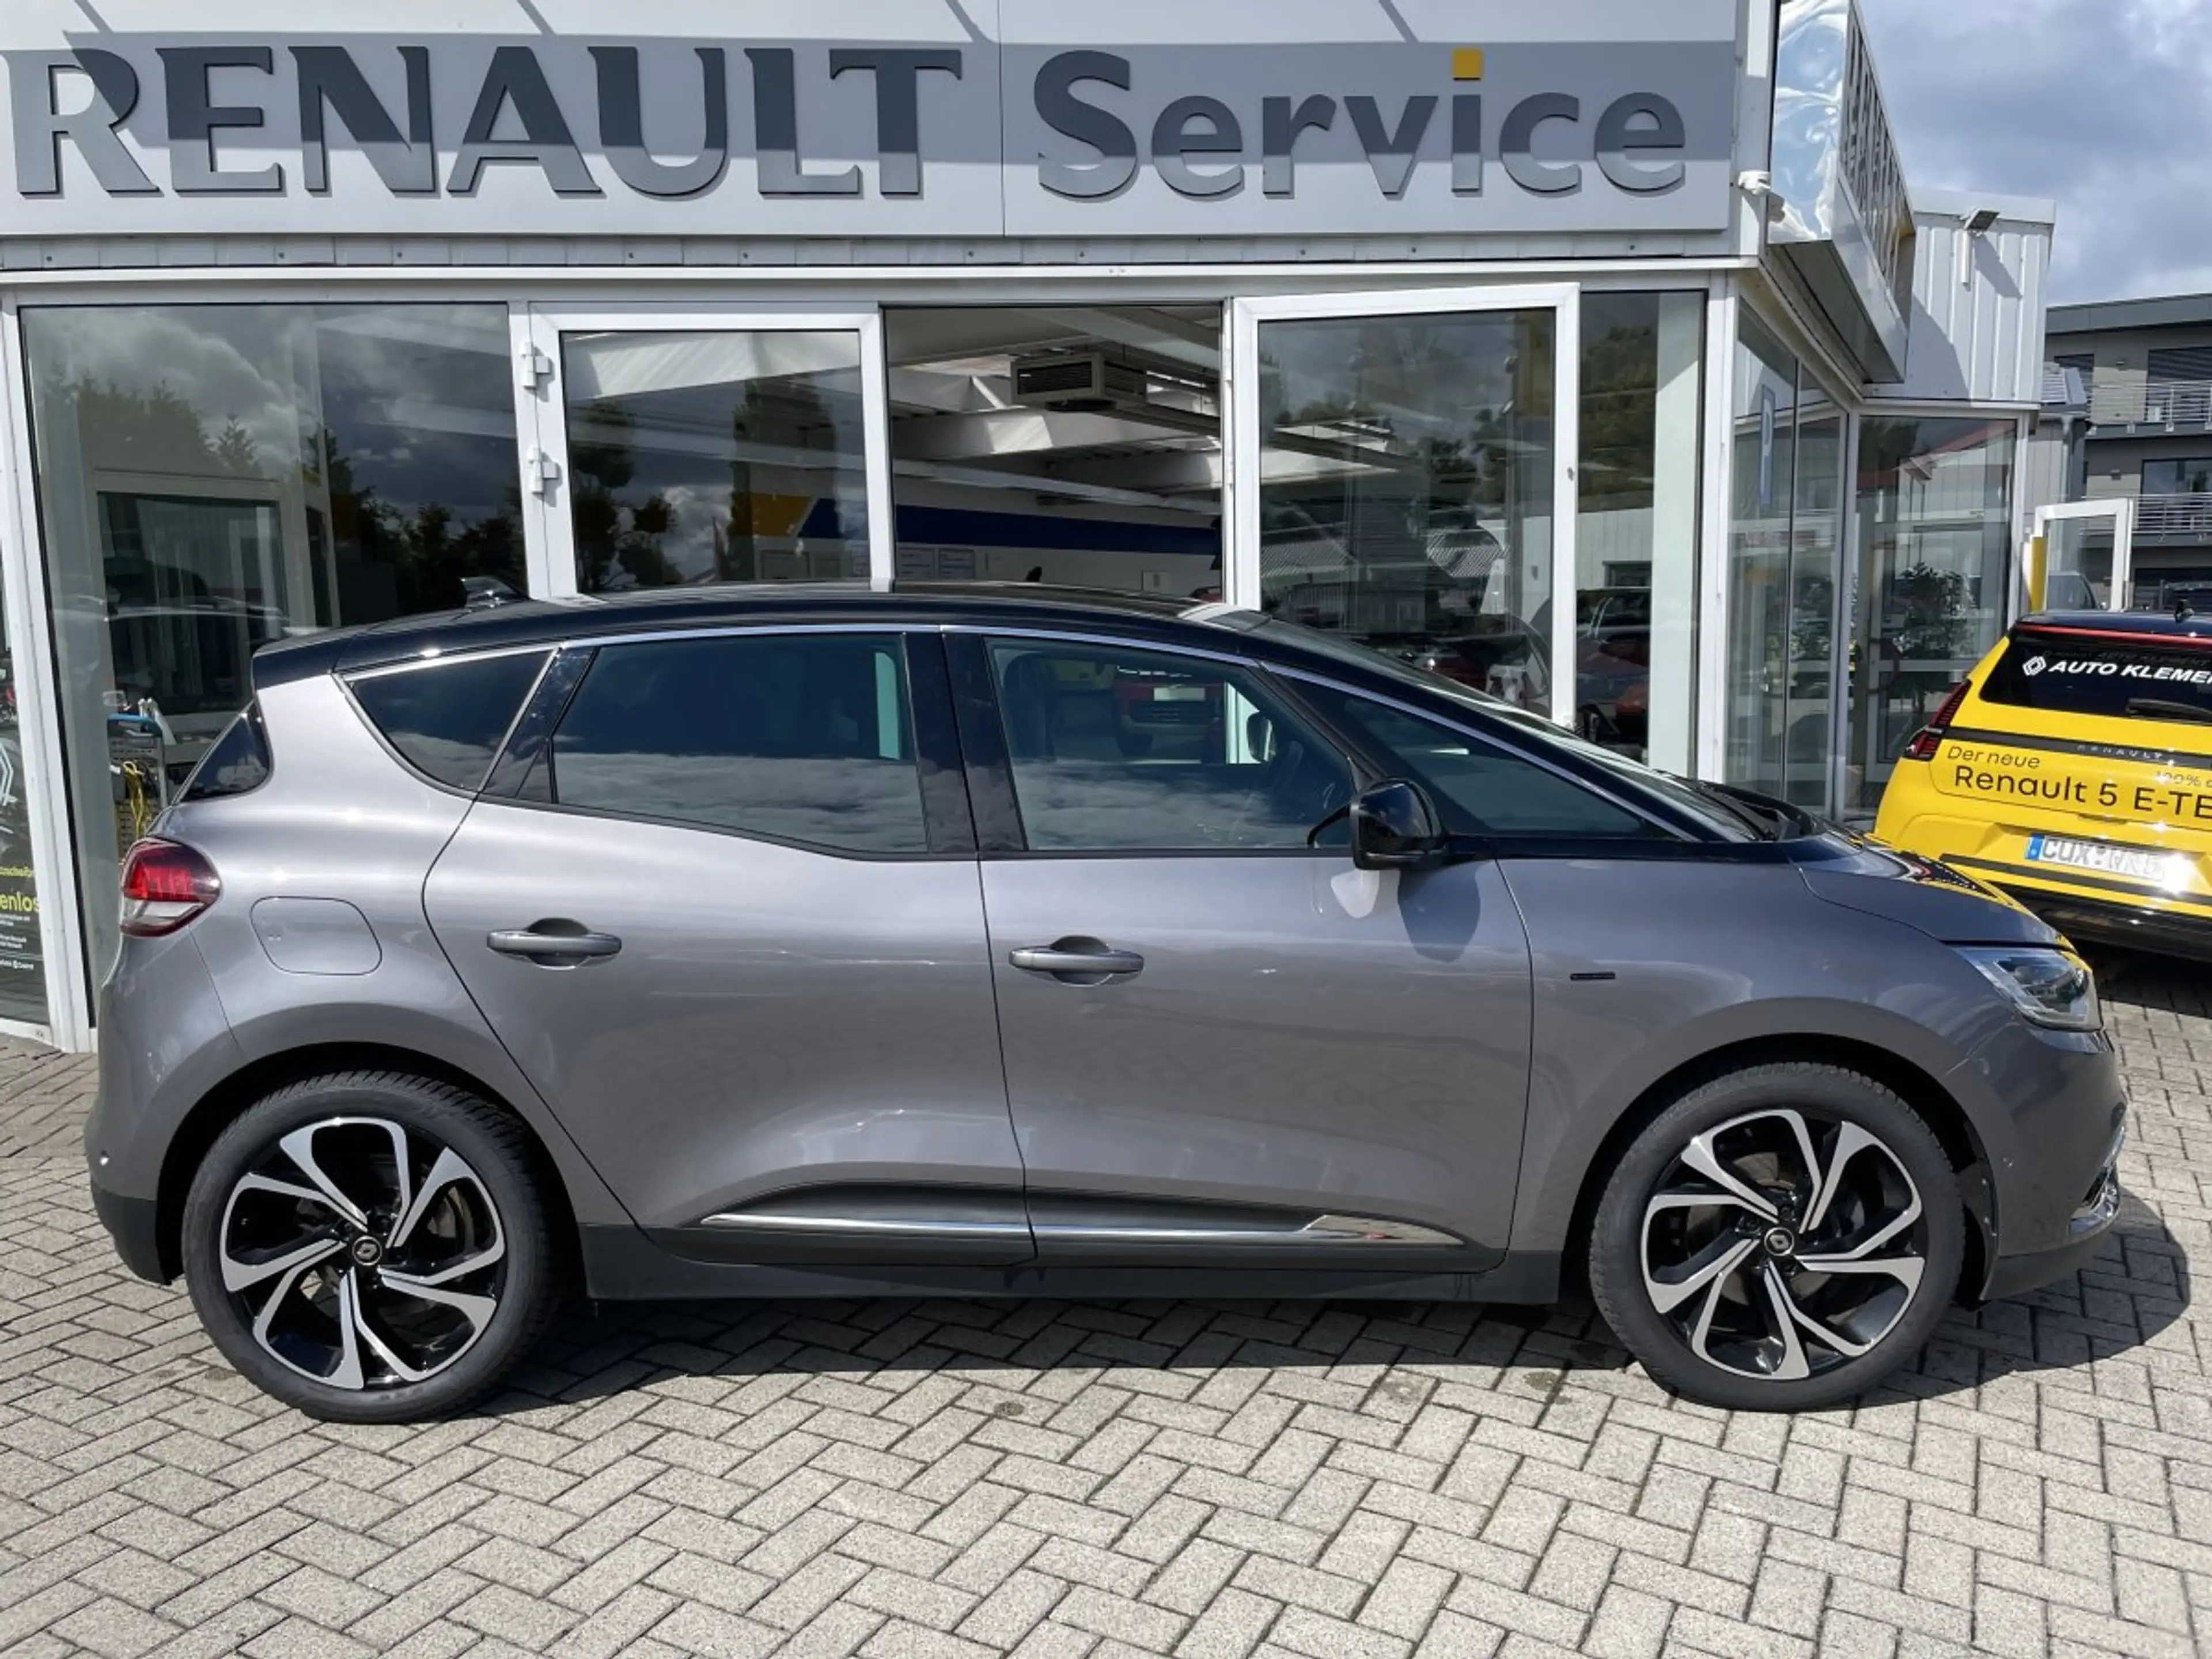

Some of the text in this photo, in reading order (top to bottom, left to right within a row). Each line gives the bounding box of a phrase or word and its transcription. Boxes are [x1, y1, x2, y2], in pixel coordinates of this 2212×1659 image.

[1, 46, 1685, 198] RENAULT Service
[2048, 661, 2118, 675] AUTO
[1947, 745, 2041, 770] Der neue
[2077, 744, 2163, 760] RENAULT
[1954, 764, 2212, 820] Renault 5 E-TE
